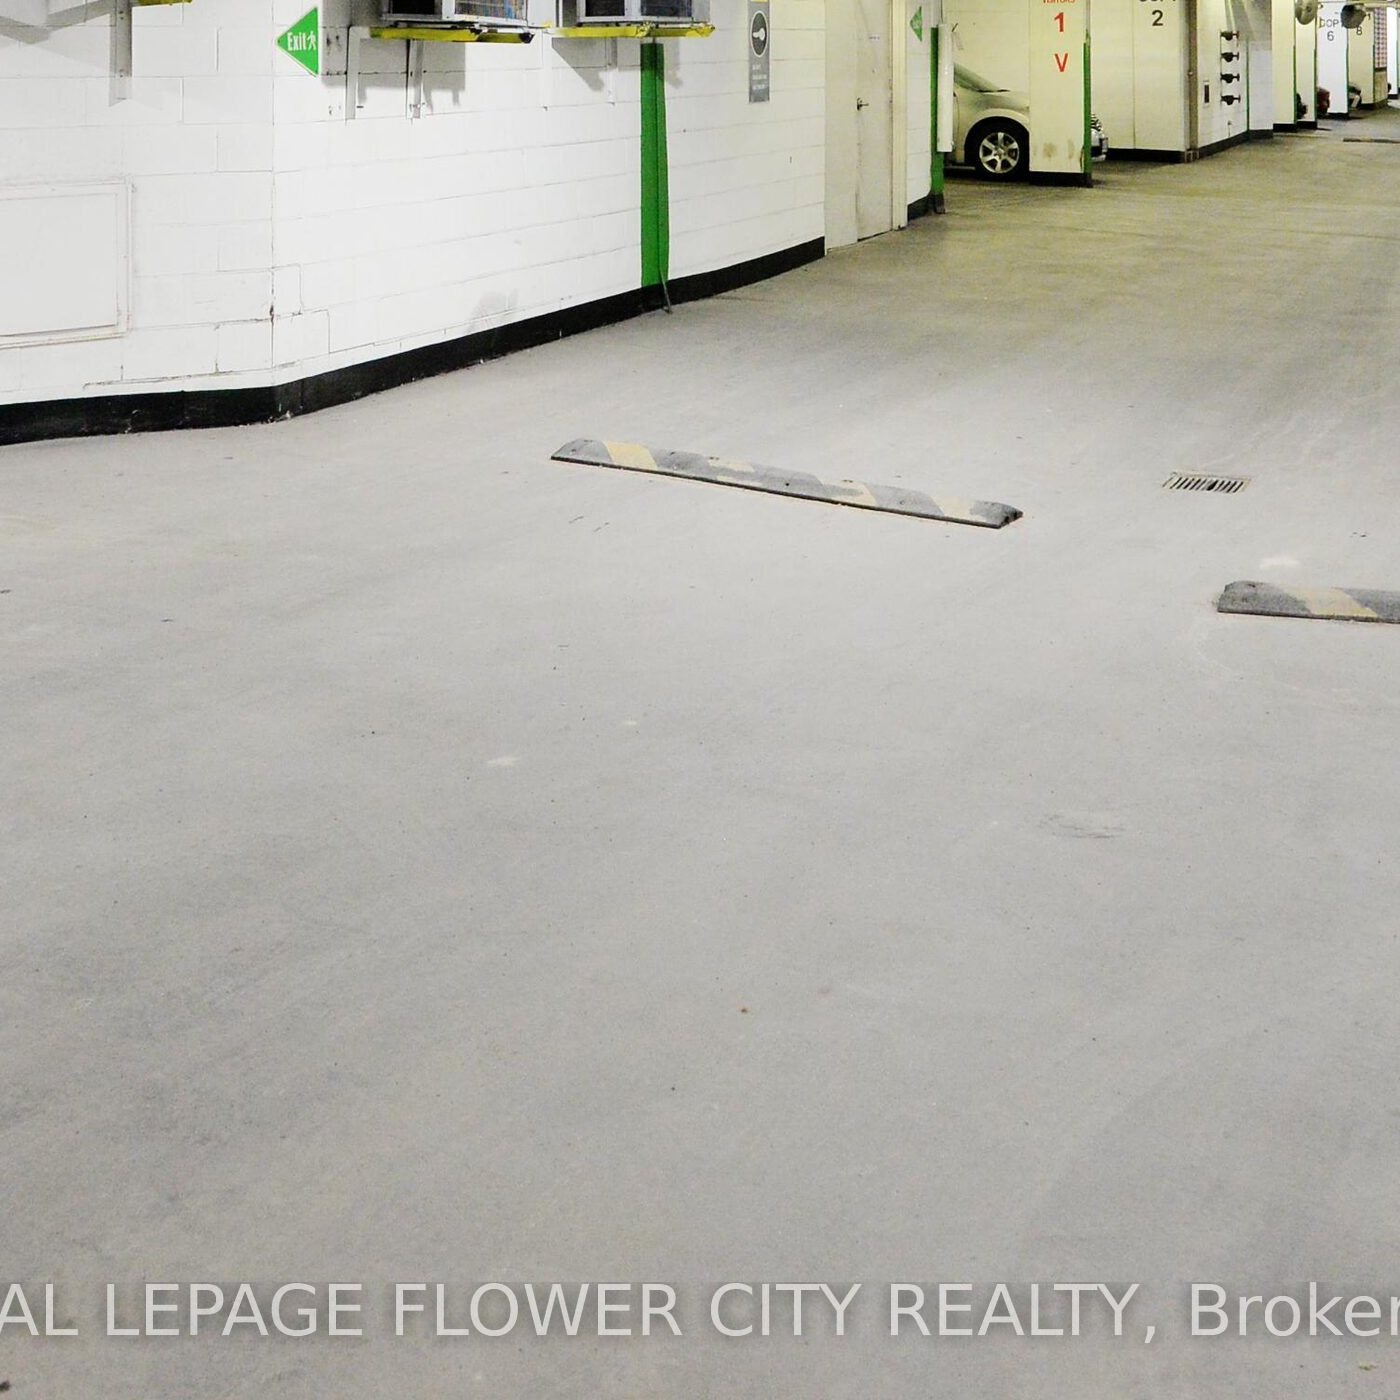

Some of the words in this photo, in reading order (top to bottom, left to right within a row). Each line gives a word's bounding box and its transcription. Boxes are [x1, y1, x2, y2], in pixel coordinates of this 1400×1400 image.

[1054, 11, 1065, 33] 1
[1151, 9, 1164, 27] 2
[287, 31, 306, 51] Exit
[1327, 30, 1335, 41] 6
[1054, 53, 1069, 73] V
